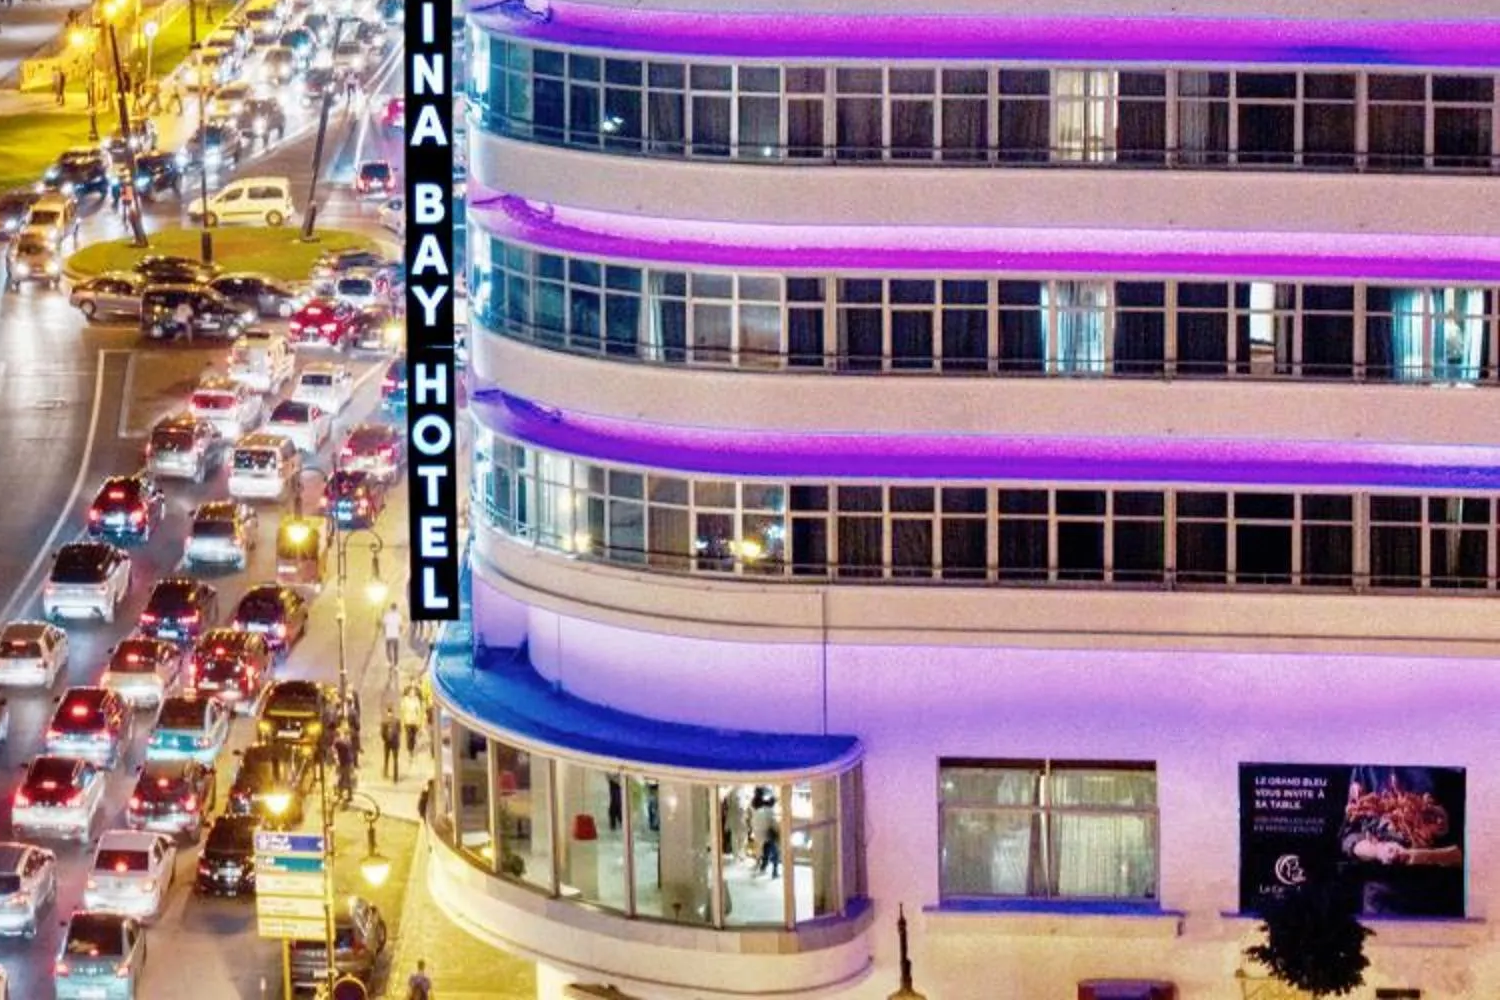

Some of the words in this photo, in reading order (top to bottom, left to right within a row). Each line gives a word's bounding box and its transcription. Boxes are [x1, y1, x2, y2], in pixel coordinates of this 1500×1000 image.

[411, 183, 449, 327] BAY
[411, 363, 452, 609] HOTEL
[1255, 789, 1281, 798] VOUS
[1283, 789, 1314, 799] INVITE
[1267, 776, 1301, 786] GRAND
